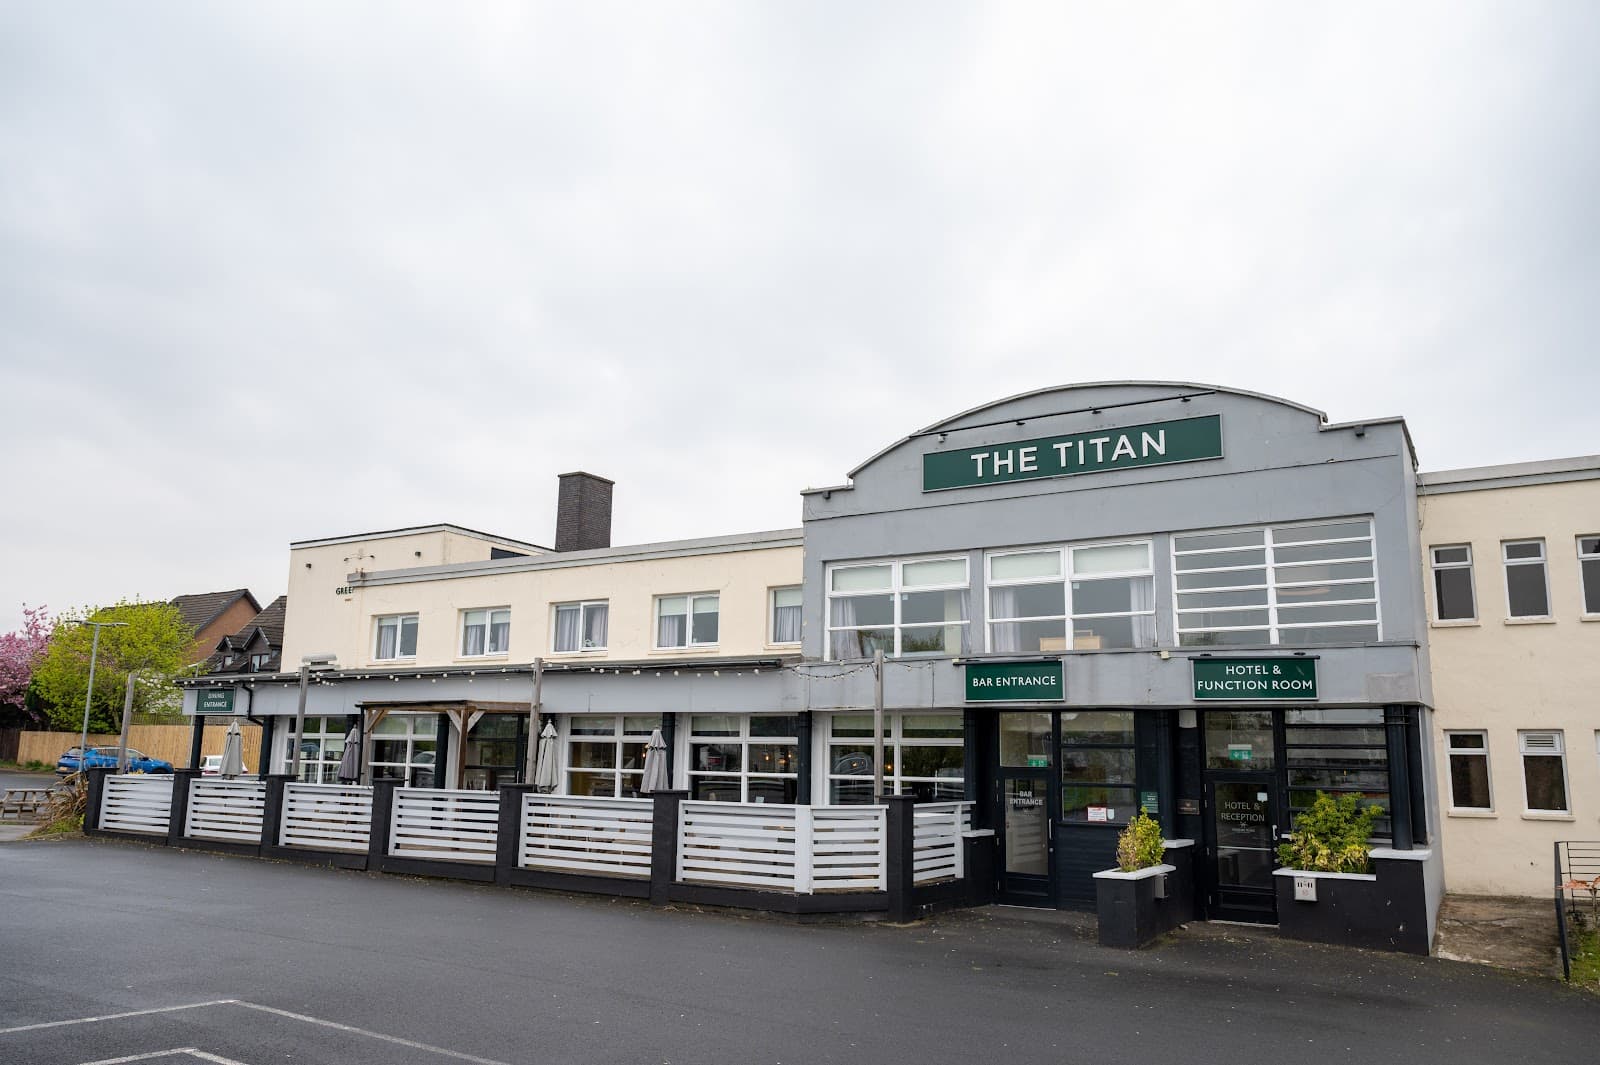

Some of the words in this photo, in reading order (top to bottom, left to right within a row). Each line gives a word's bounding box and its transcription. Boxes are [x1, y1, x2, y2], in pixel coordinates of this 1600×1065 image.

[971, 447, 1038, 477] THE
[1053, 429, 1166, 467] TITAN
[336, 586, 354, 595] GREE
[1226, 665, 1269, 675] HOTEL
[1272, 665, 1282, 675] &
[973, 678, 993, 687] BAR
[996, 675, 1056, 686] ENTRANCE
[1197, 680, 1268, 691] FUNCTION
[1272, 680, 1313, 690] ROOM
[1224, 801, 1251, 810] HOTEL
[1220, 813, 1265, 822] RECEPTION
